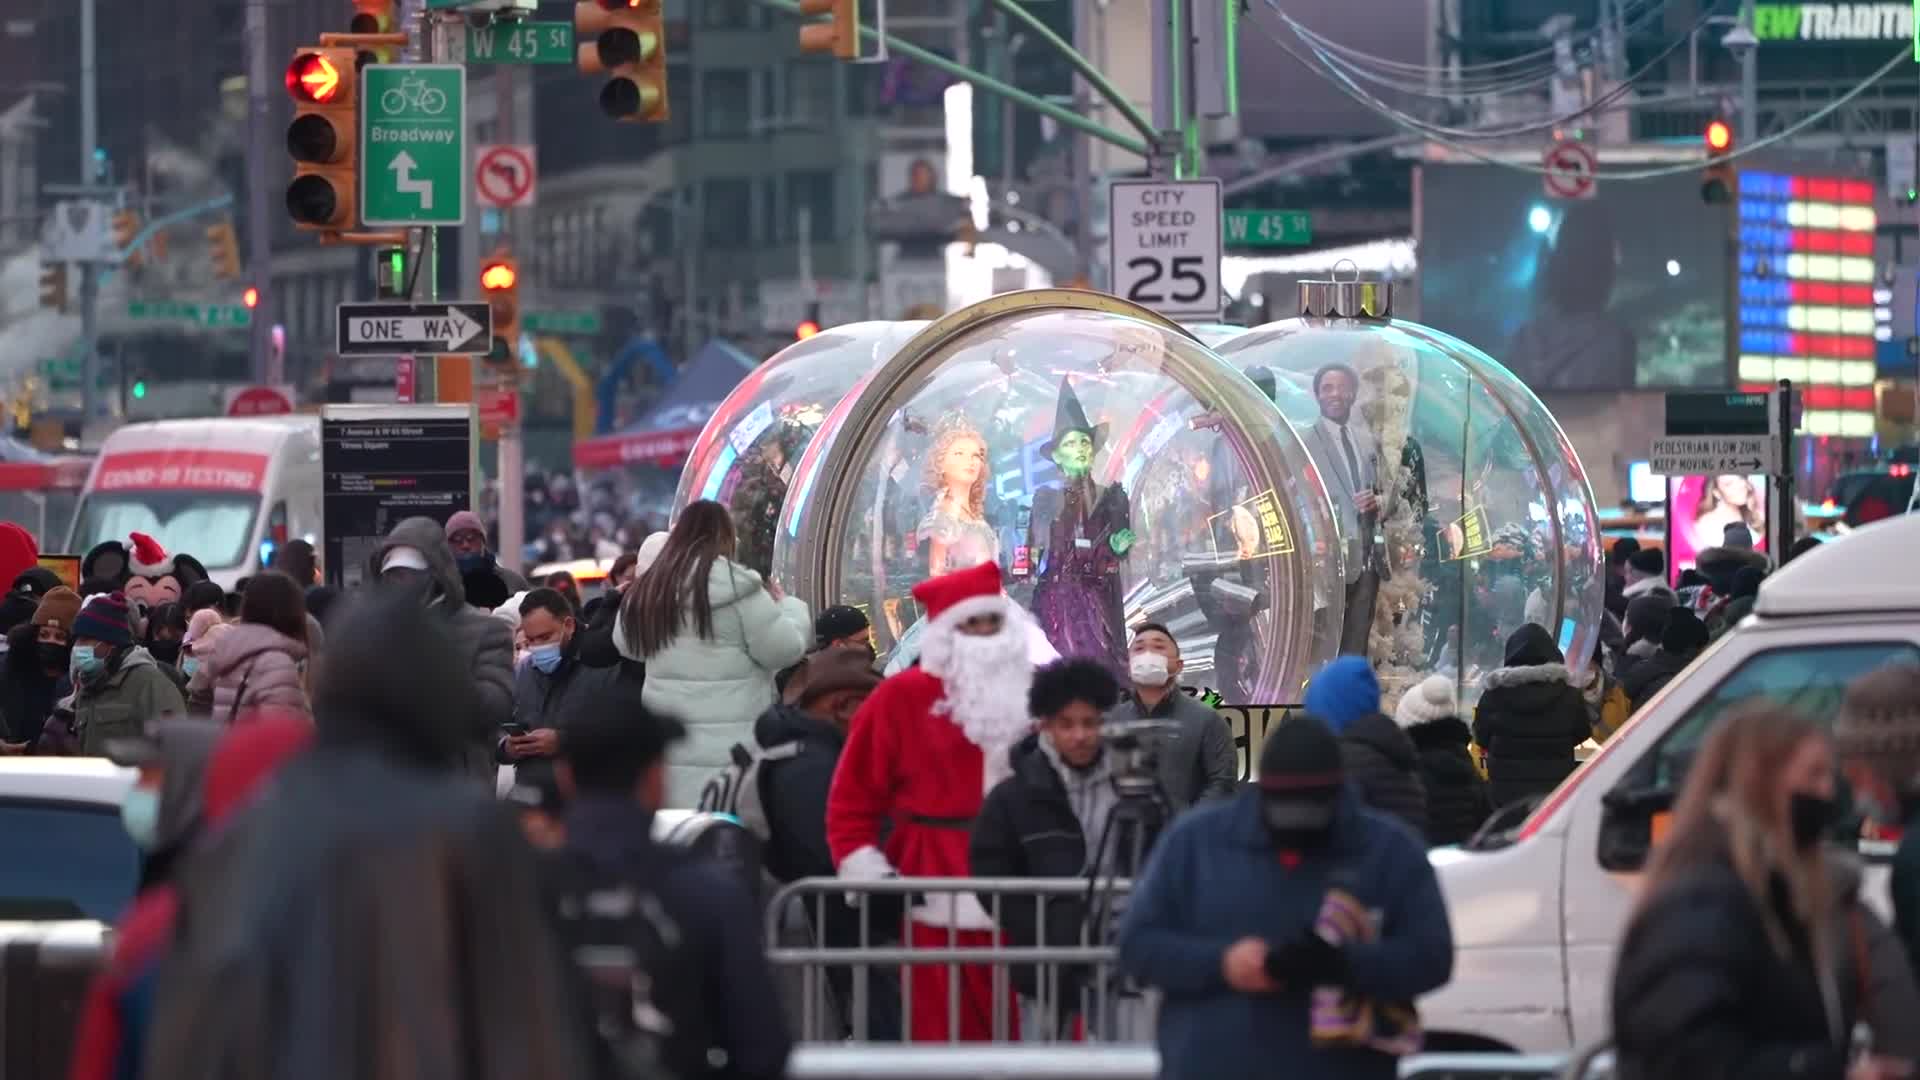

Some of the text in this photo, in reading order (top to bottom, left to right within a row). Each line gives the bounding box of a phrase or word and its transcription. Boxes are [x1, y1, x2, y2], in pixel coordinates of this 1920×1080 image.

[472, 28, 566, 59] W 45 St
[371, 126, 455, 145] Broadway
[1141, 190, 1184, 206] CITY
[1132, 210, 1195, 228] SPEED
[1228, 215, 1307, 241] W 45 St
[1138, 232, 1188, 249] LIMIT
[1127, 255, 1207, 304] 25
[360, 319, 466, 340] ONE WAY
[1653, 440, 1762, 455] PEDESTRIAN FLOW ZONE
[1653, 457, 1716, 472] KEEP MOVING
